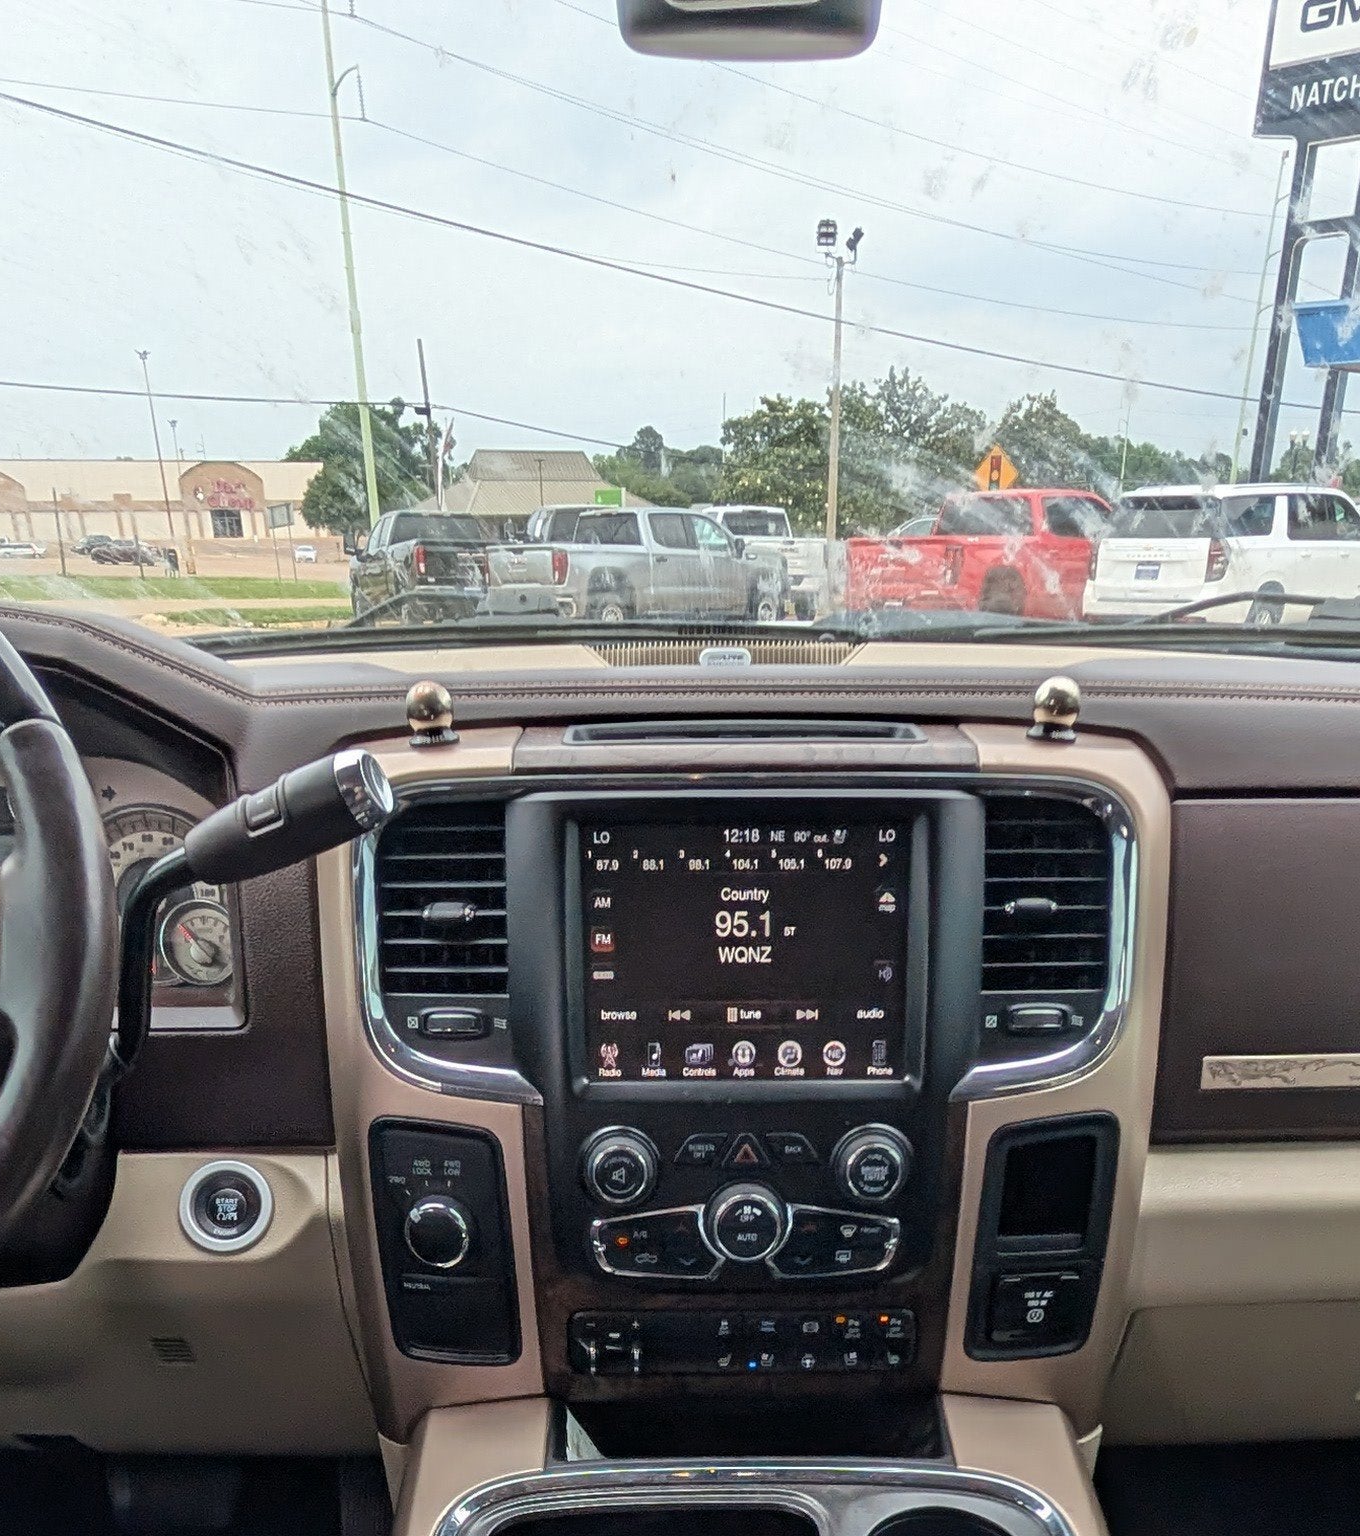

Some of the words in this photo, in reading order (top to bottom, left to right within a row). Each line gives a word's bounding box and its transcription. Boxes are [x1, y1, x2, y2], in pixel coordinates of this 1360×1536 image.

[593, 831, 610, 844] LO
[723, 828, 760, 843] 12:18
[770, 830, 786, 842] NE
[879, 829, 896, 843] LO
[721, 887, 769, 904] Country
[594, 897, 611, 908] AM
[715, 910, 771, 938] 95.1
[595, 933, 611, 945] FM
[718, 946, 772, 964] WQNZ
[601, 1009, 637, 1020] browse
[740, 1009, 761, 1019] tune
[856, 1009, 884, 1019] audio
[598, 1067, 622, 1077] Radio
[641, 1067, 666, 1077] Media
[682, 1067, 717, 1077] Controls
[733, 1067, 755, 1077] Apps
[867, 1066, 893, 1076] Phone
[737, 1233, 758, 1242] AUTO
